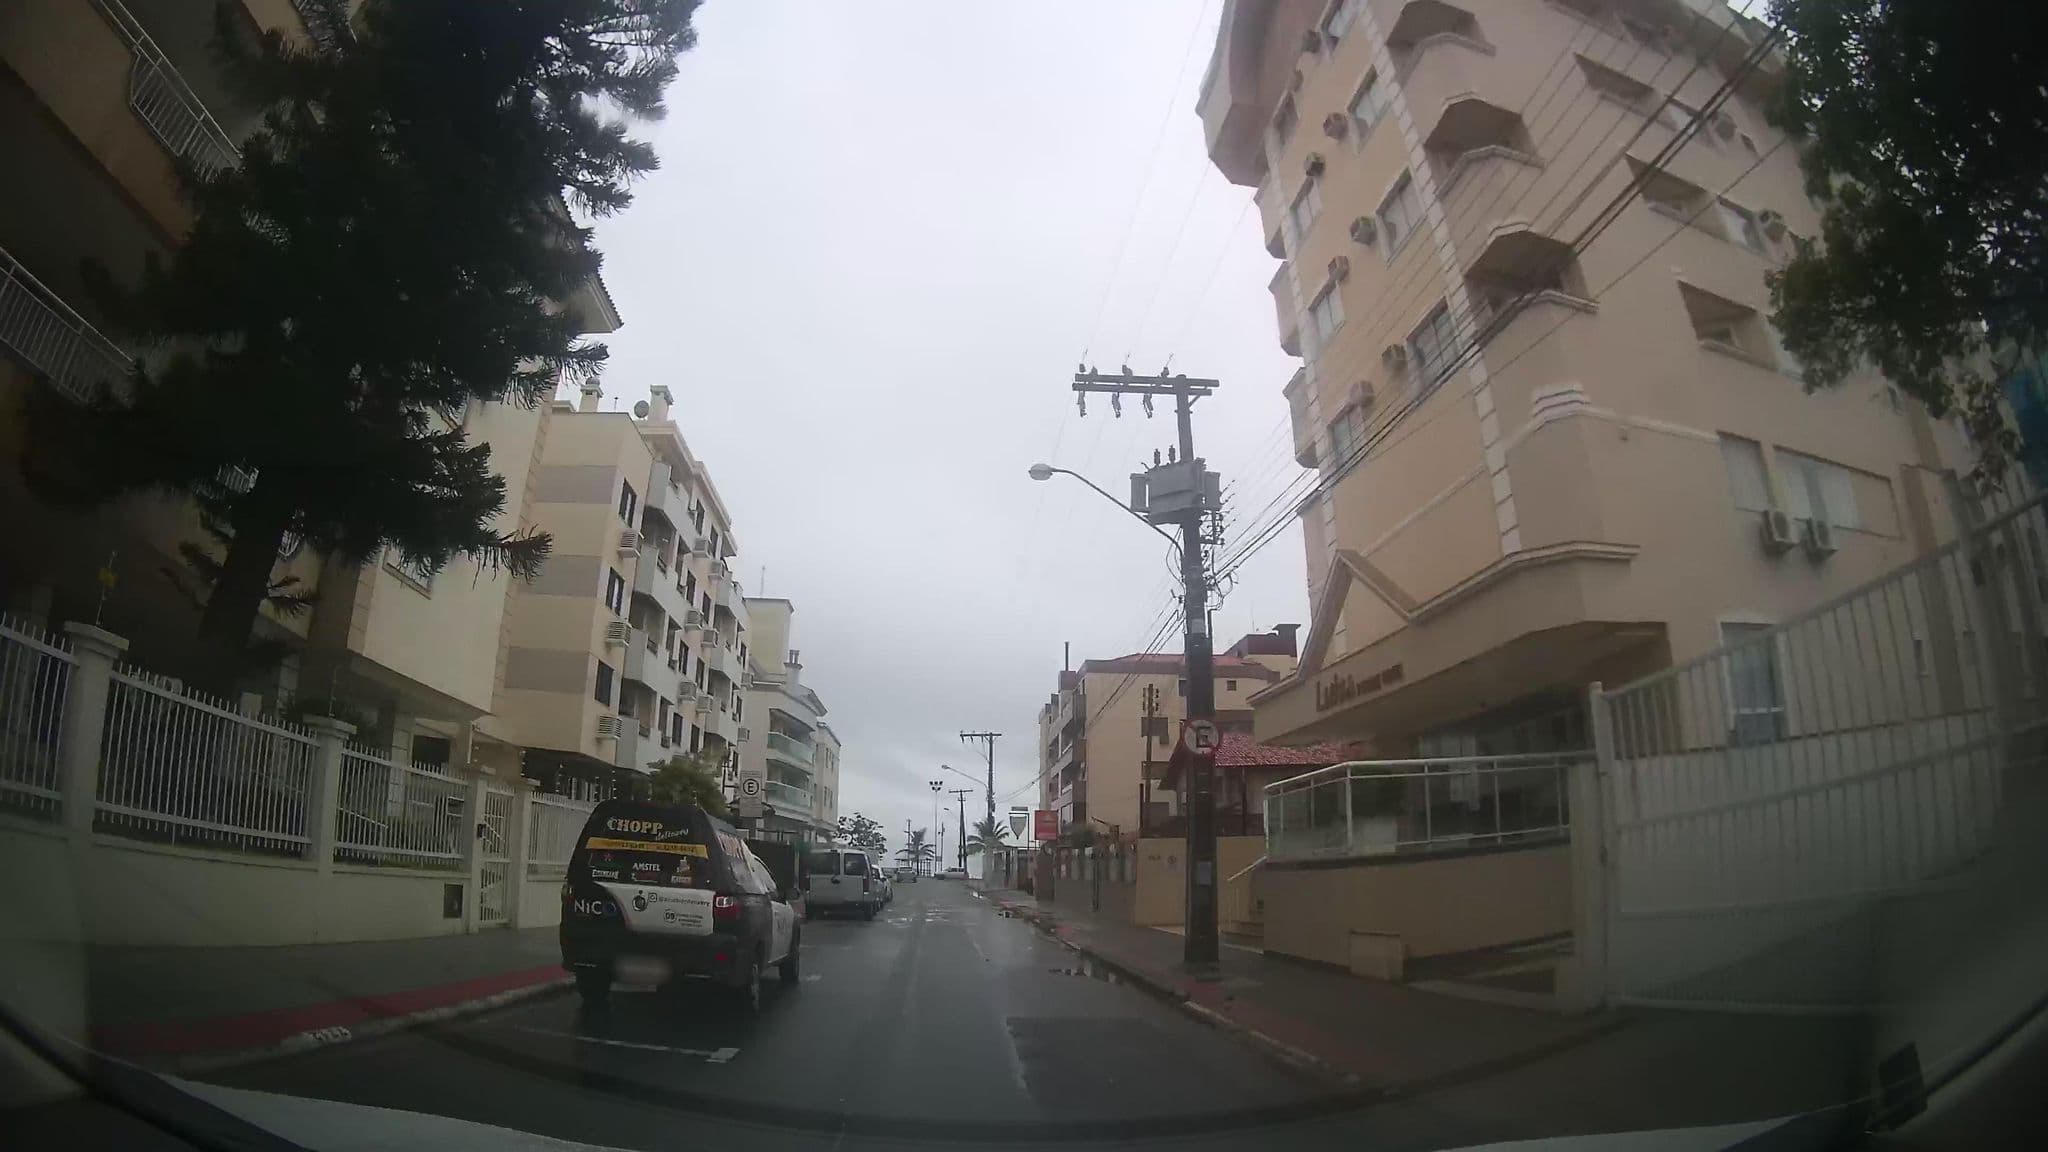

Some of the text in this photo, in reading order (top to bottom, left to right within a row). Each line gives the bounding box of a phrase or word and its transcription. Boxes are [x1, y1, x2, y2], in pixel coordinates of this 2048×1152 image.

[1196, 726, 1211, 748] E
[747, 782, 754, 792] E
[607, 816, 663, 835] CHOPP
[632, 862, 661, 872] AMSTEL
